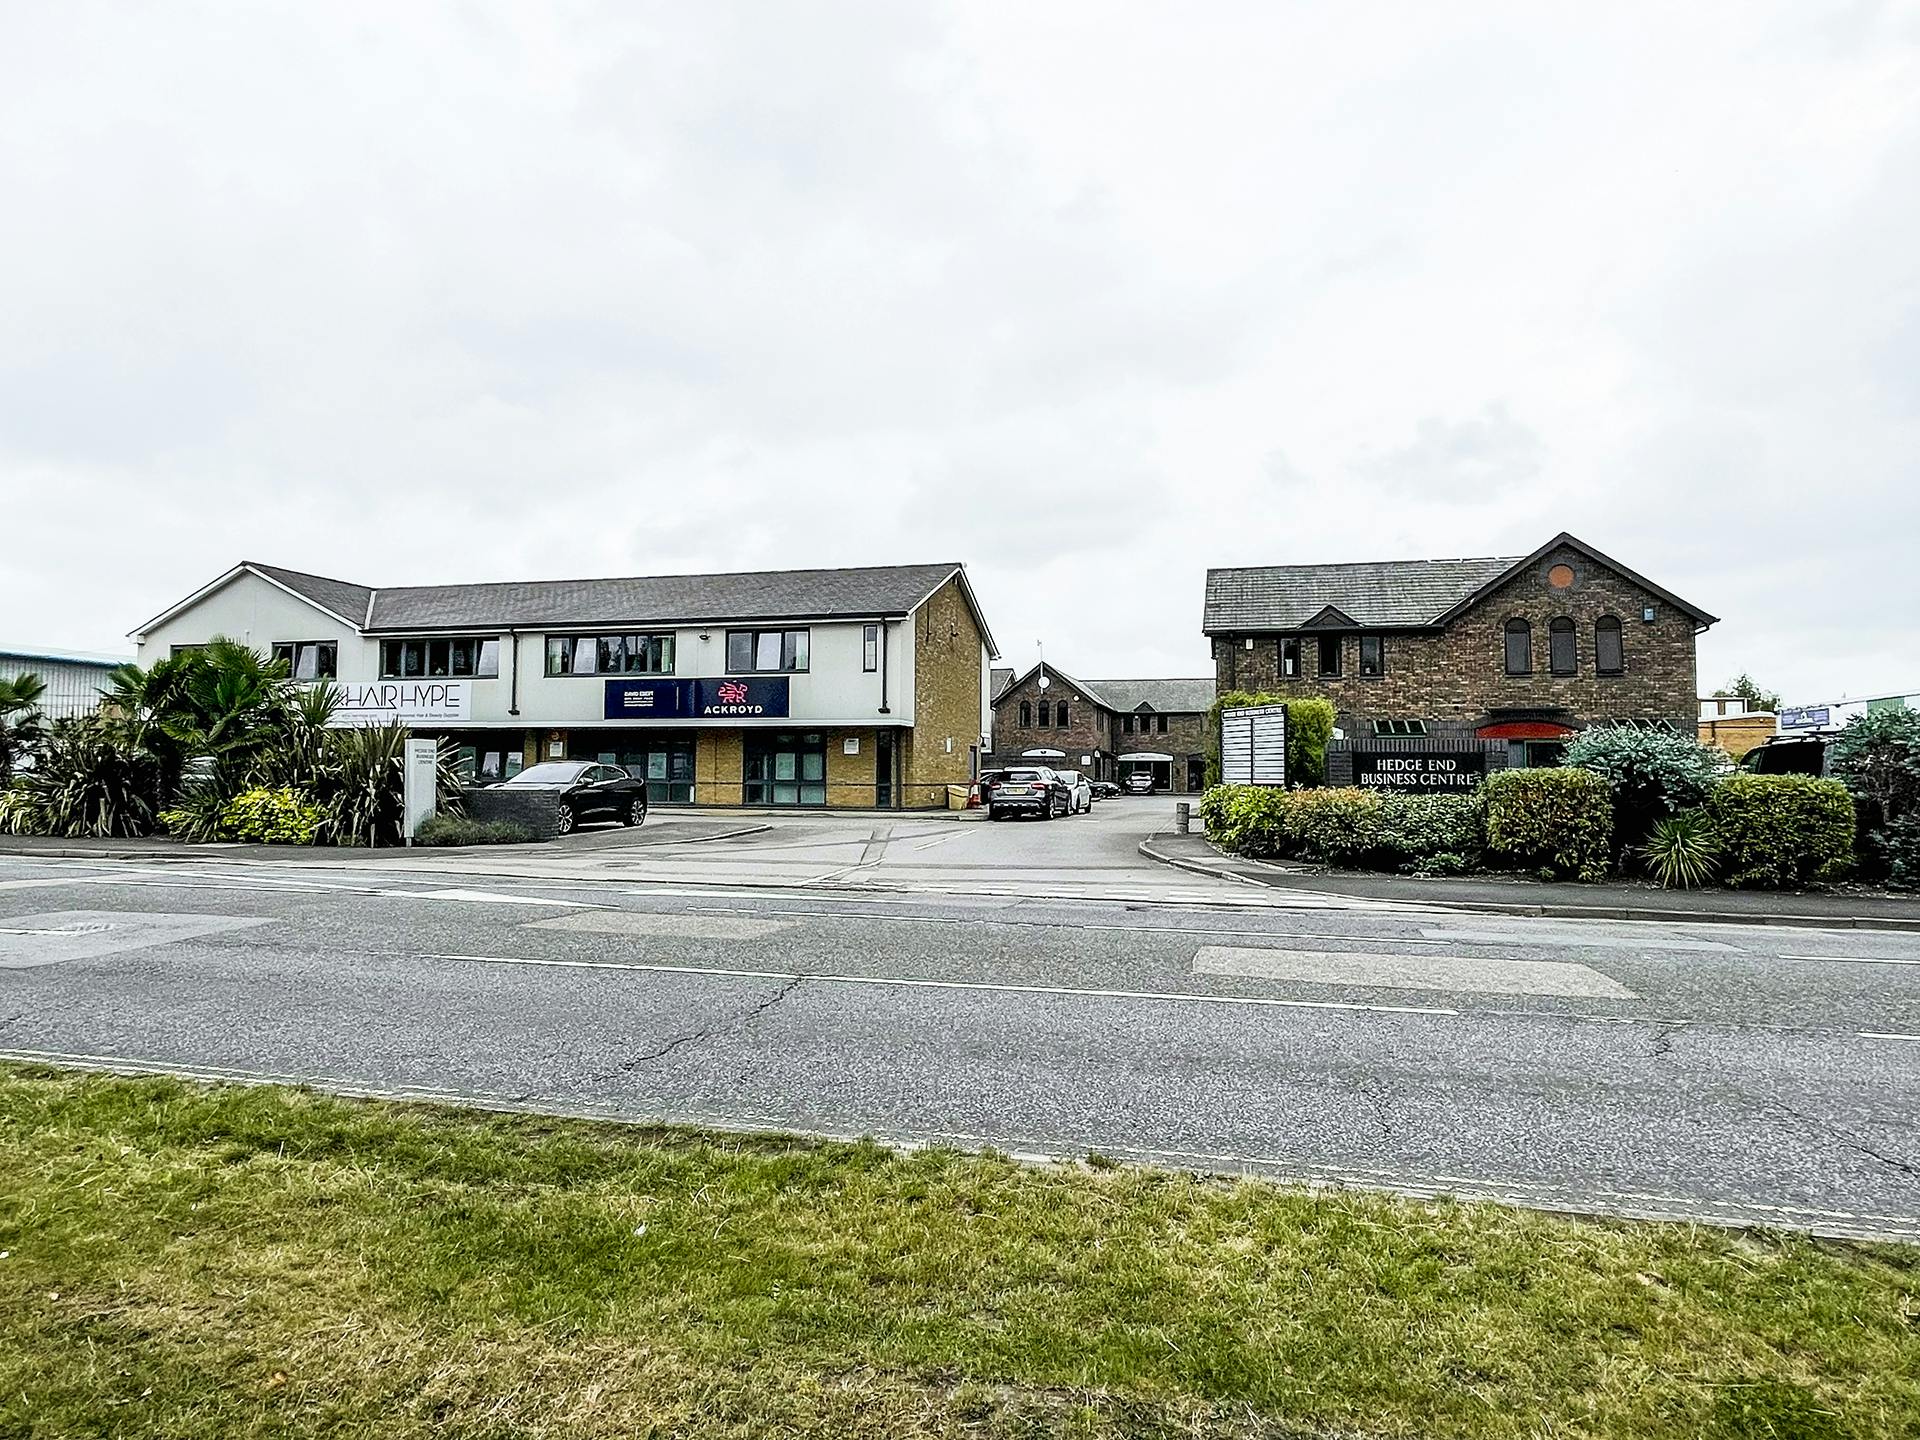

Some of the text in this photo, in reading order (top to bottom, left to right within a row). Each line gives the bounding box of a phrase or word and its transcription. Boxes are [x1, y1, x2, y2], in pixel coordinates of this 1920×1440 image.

[704, 705, 763, 714] ACKROYD
[1376, 759, 1457, 771] HEDGE END
[1361, 773, 1475, 785] BUSINESS CENTRE
